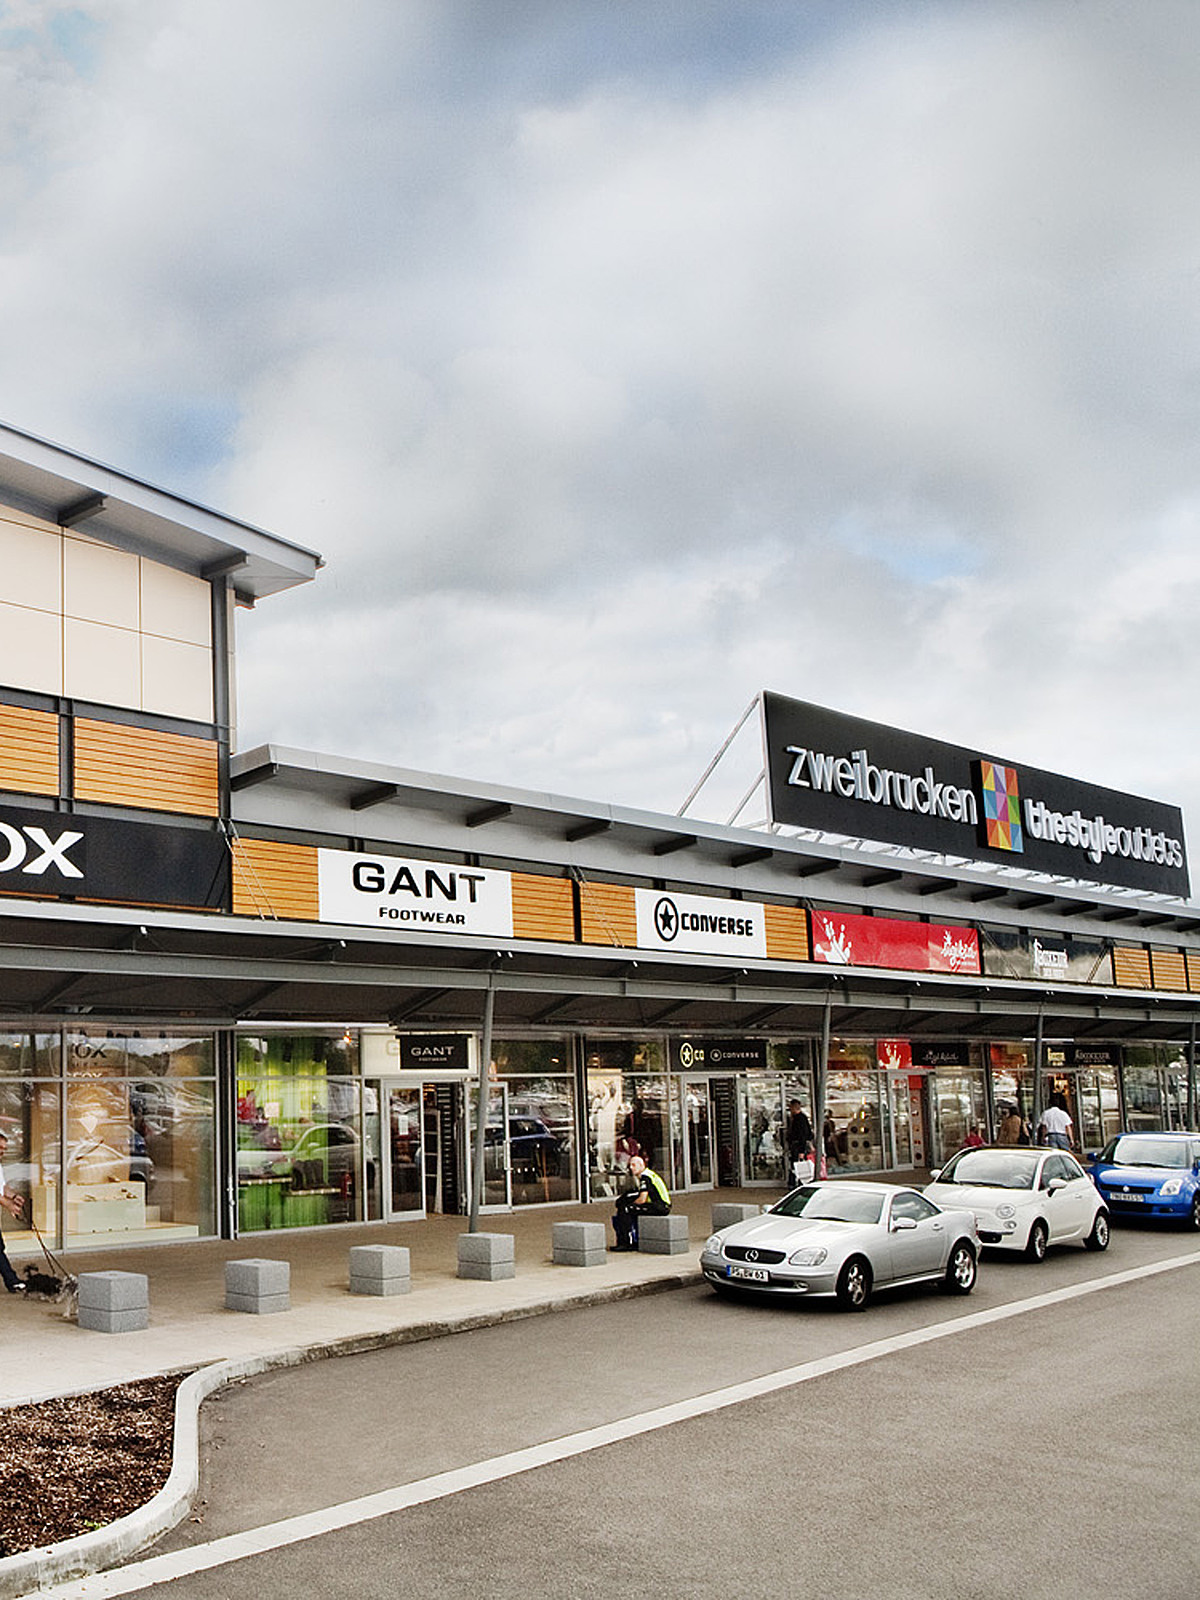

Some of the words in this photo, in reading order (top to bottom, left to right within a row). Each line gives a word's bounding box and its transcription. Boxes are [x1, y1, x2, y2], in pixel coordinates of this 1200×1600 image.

[352, 861, 486, 903] GANT
[379, 906, 466, 925] FOOTWEAR
[680, 912, 753, 936] CONVERSE
[410, 1046, 455, 1057] GANT
